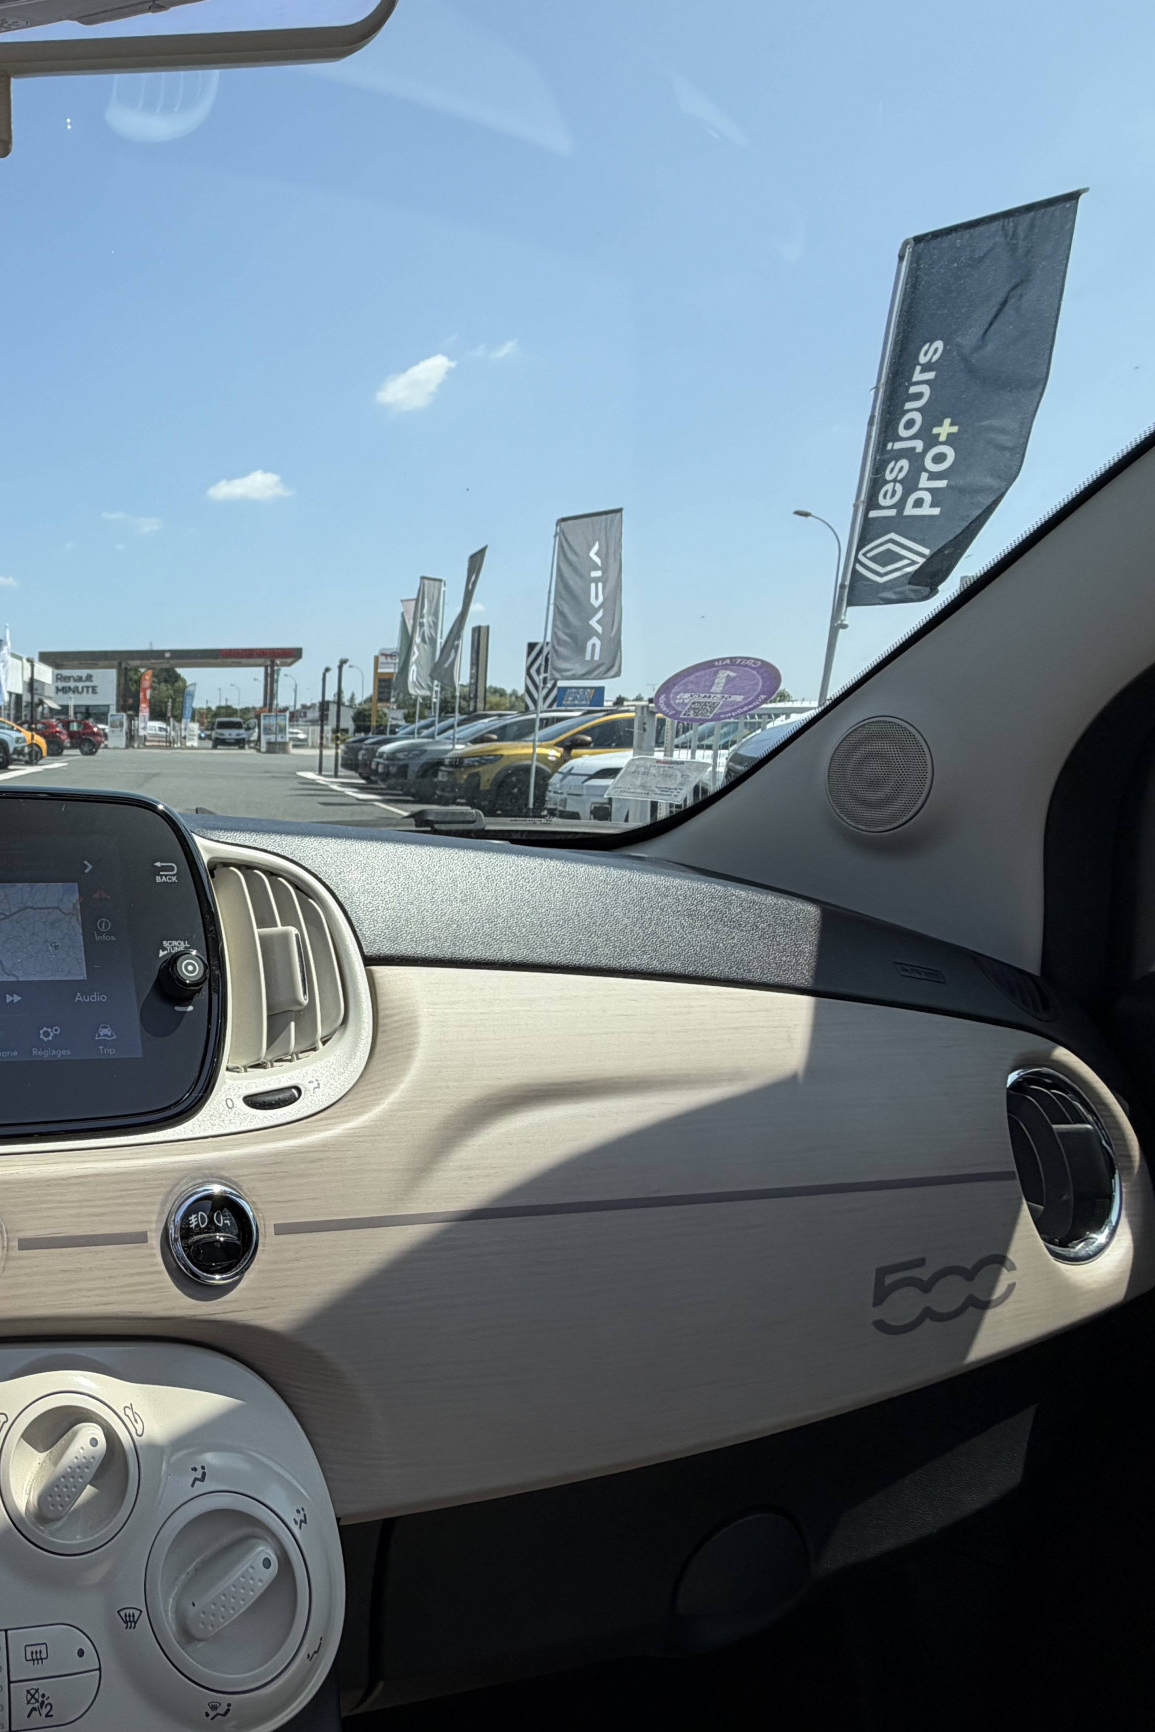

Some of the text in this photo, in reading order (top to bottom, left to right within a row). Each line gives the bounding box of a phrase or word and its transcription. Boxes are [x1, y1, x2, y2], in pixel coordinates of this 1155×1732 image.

[868, 339, 944, 518] les jours
[903, 417, 959, 517] pro+
[585, 541, 602, 661] DACIA
[55, 672, 94, 683] Renault
[55, 685, 99, 695] MINUTE
[94, 933, 116, 941] Infos
[74, 991, 107, 1003] Audio
[32, 1046, 71, 1057] Réglages
[98, 1045, 116, 1055] Trip
[225, 1097, 235, 1110] 0
[872, 1254, 1017, 1336] 500
